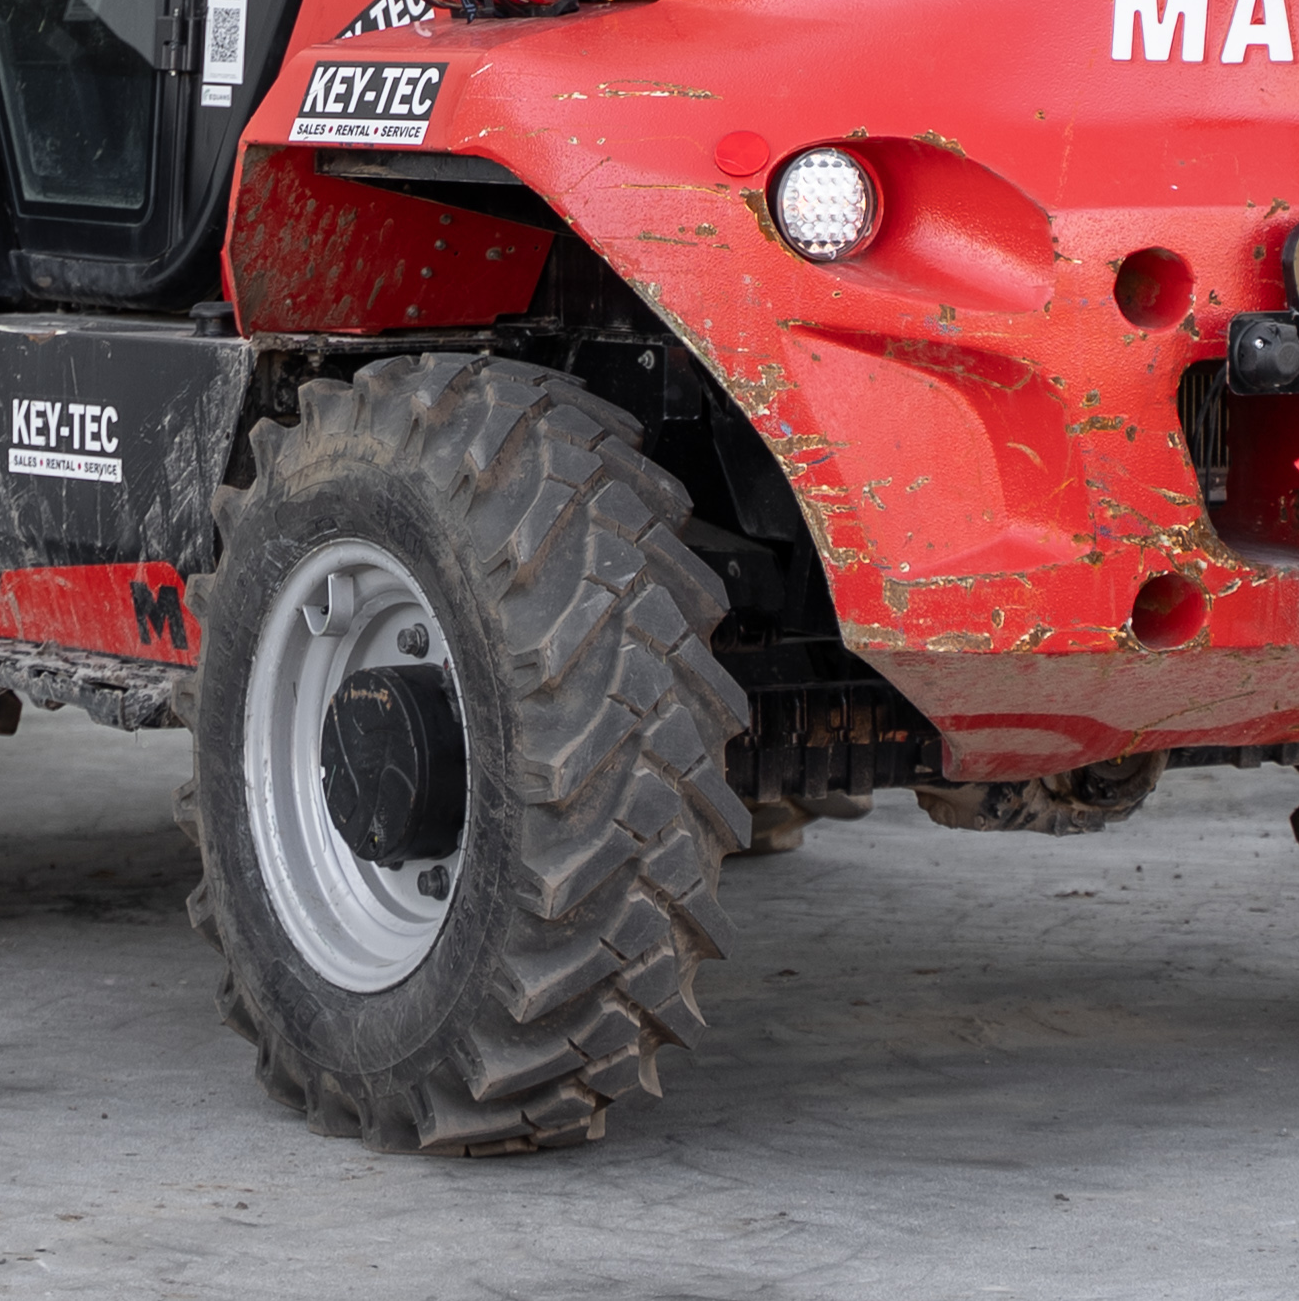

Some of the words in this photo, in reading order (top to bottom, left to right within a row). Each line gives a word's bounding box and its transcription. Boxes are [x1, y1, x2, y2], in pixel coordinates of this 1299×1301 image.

[303, 66, 440, 115] KEY-TEC
[297, 123, 326, 135] SALES
[335, 124, 370, 136] RENTAL
[381, 126, 422, 138] SERVICE
[12, 398, 119, 453] KEY-TEC
[14, 455, 37, 467] SALES
[46, 458, 75, 471] RENTAL
[84, 462, 117, 476] SERVICE
